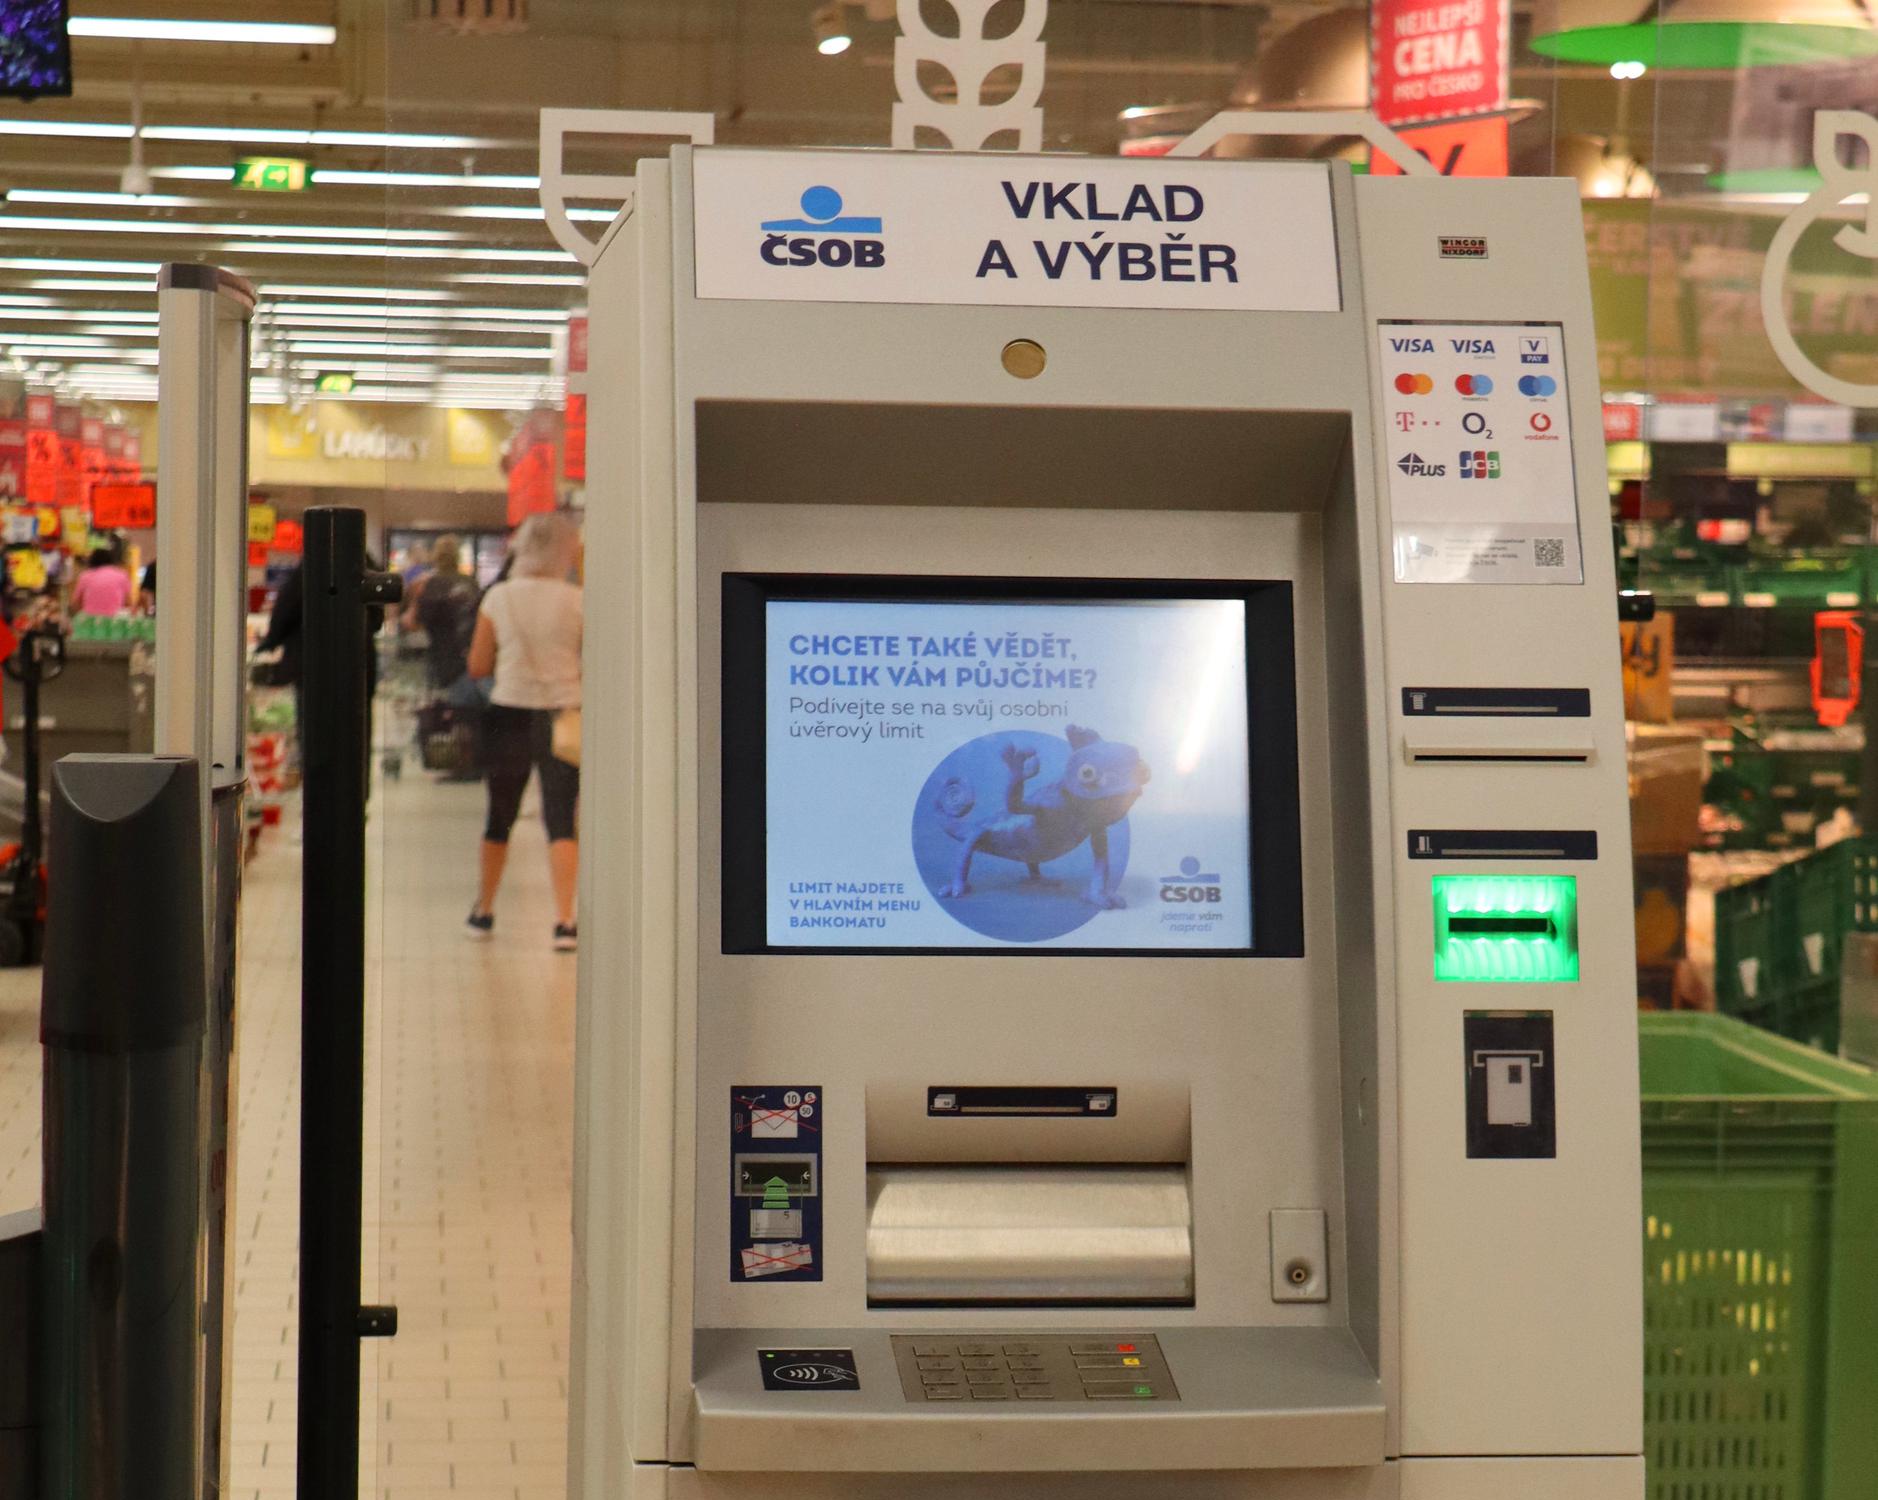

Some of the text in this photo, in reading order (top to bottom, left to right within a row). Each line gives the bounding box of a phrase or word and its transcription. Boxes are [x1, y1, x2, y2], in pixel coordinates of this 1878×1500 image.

[1394, 28, 1483, 77] CENA
[1001, 180, 1204, 223] VKLAD
[760, 233, 885, 268] ČSOB
[975, 231, 1238, 284] A VÝBĚR
[1389, 338, 1434, 353] VISA
[1449, 339, 1495, 353] VISA
[1525, 340, 1540, 351] V
[1526, 355, 1543, 363] PAY
[1411, 464, 1446, 477] PLUS
[789, 632, 1077, 661] CHCETE TAKÉ VĚDĚT,
[789, 660, 1097, 689] KOLIK VÁM PŮJČÍME?
[789, 696, 1069, 720] Podívejte se na svůj osobní
[789, 719, 925, 743] úvěrový limit
[789, 882, 904, 894] LIMIT NAJDETE
[1160, 885, 1222, 903] ČSOB
[790, 896, 921, 911] V HLAVNÍM MENU
[789, 916, 886, 928] BANKOMATU
[786, 1095, 798, 1104] 10
[802, 1107, 811, 1115] 50
